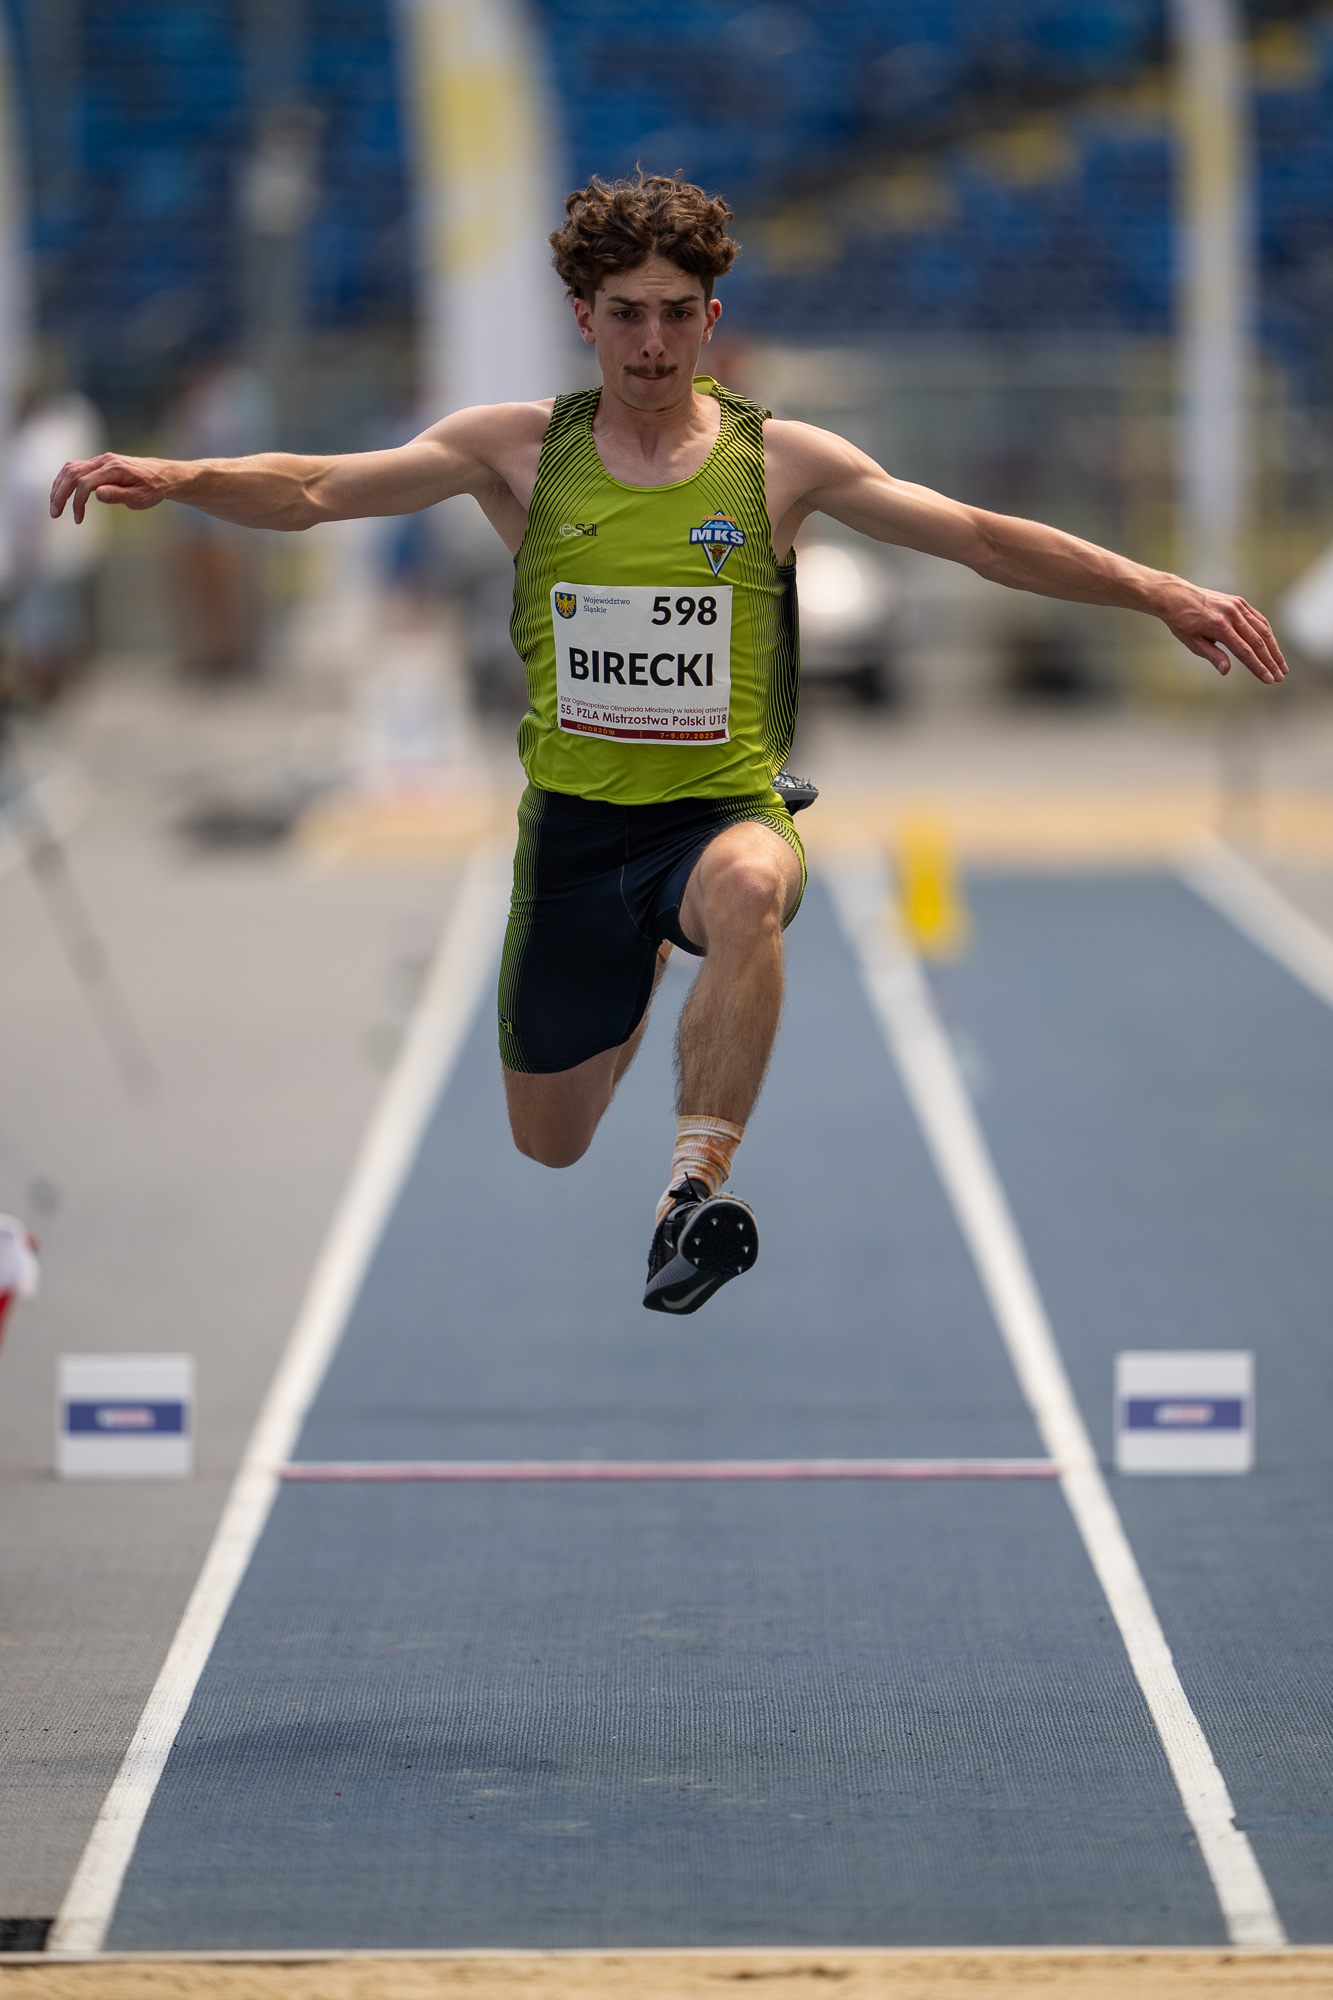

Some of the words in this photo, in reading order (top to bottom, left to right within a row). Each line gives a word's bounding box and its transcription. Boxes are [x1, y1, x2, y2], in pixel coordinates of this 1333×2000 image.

[691, 529, 744, 545] MKS
[583, 596, 631, 605] Województwo
[583, 604, 607, 613] Śląskie
[651, 596, 718, 626] 598
[569, 647, 714, 687] BIRECKI
[561, 704, 574, 715] 55.
[577, 707, 599, 720] PZLA
[602, 712, 668, 726] Mistrzostwa
[672, 715, 705, 726] Polski
[709, 714, 727, 725] U18
[610, 705, 643, 713] Olimpiada
[645, 706, 675, 714] Młodzieży
[576, 724, 615, 736] CHORZÓW
